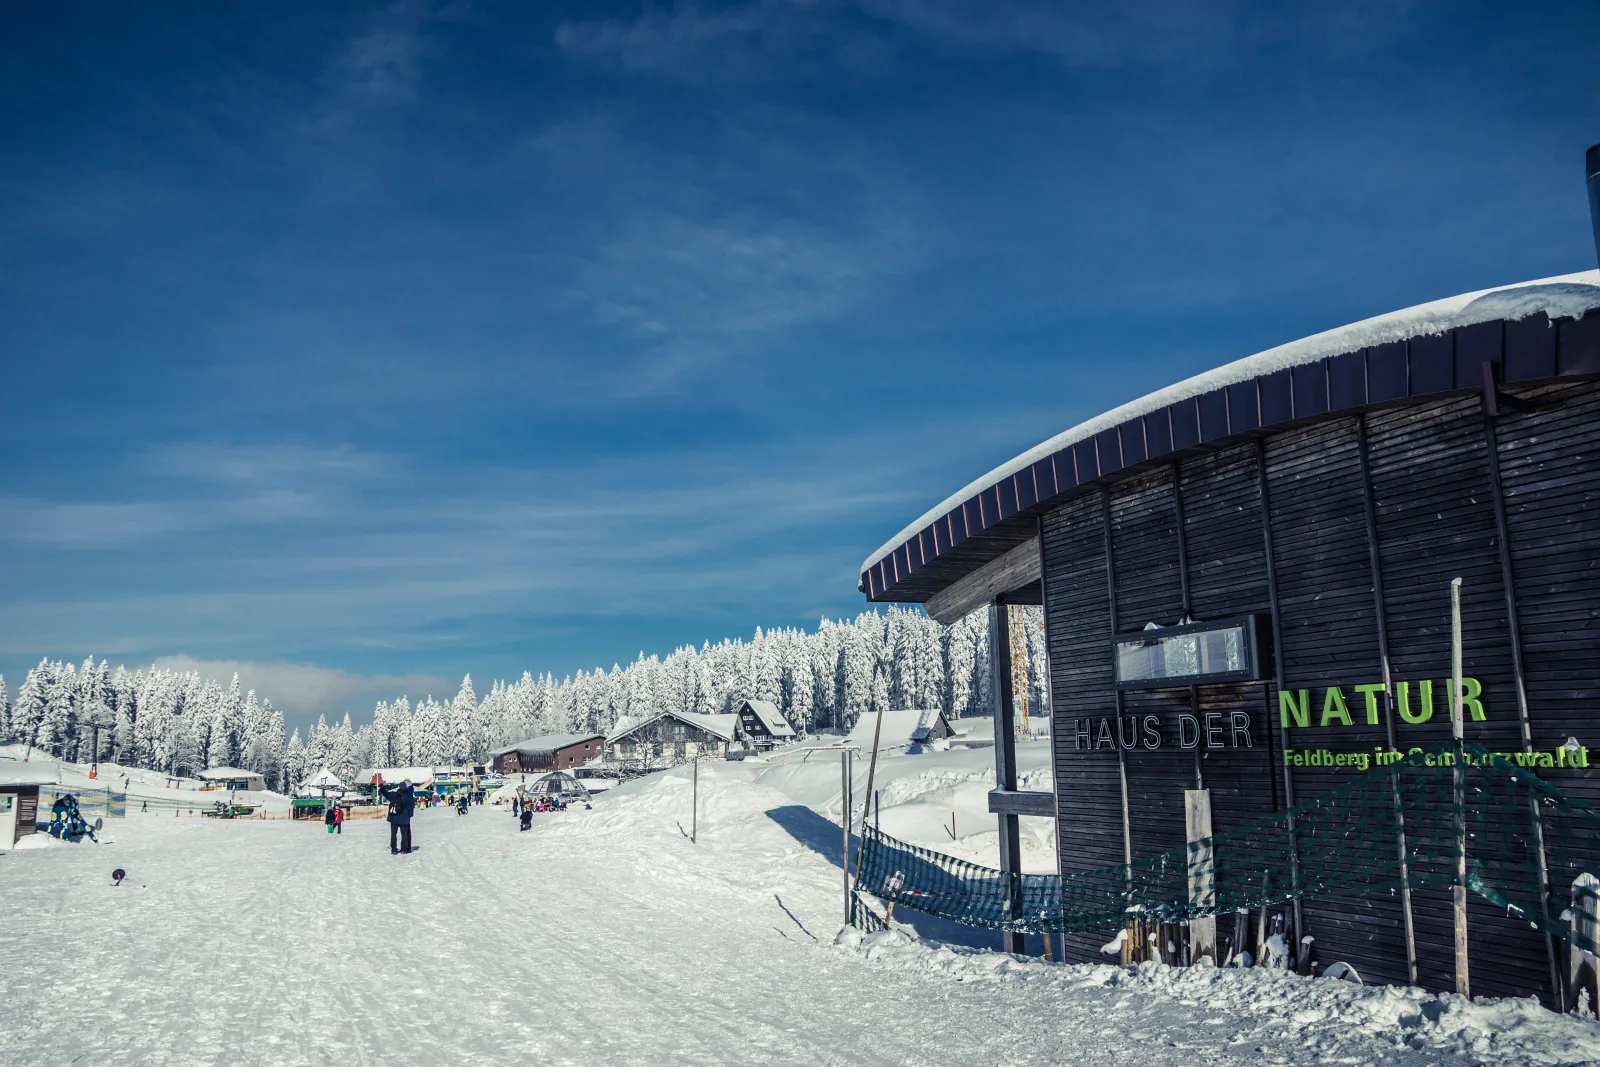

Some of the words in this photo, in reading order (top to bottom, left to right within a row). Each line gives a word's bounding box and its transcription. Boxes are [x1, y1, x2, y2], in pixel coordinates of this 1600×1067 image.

[1074, 715, 1162, 750] HAUS
[1178, 711, 1253, 749] DER
[1279, 677, 1487, 728] NATUR
[1283, 749, 1369, 771] Feldberg
[1374, 746, 1404, 766] im
